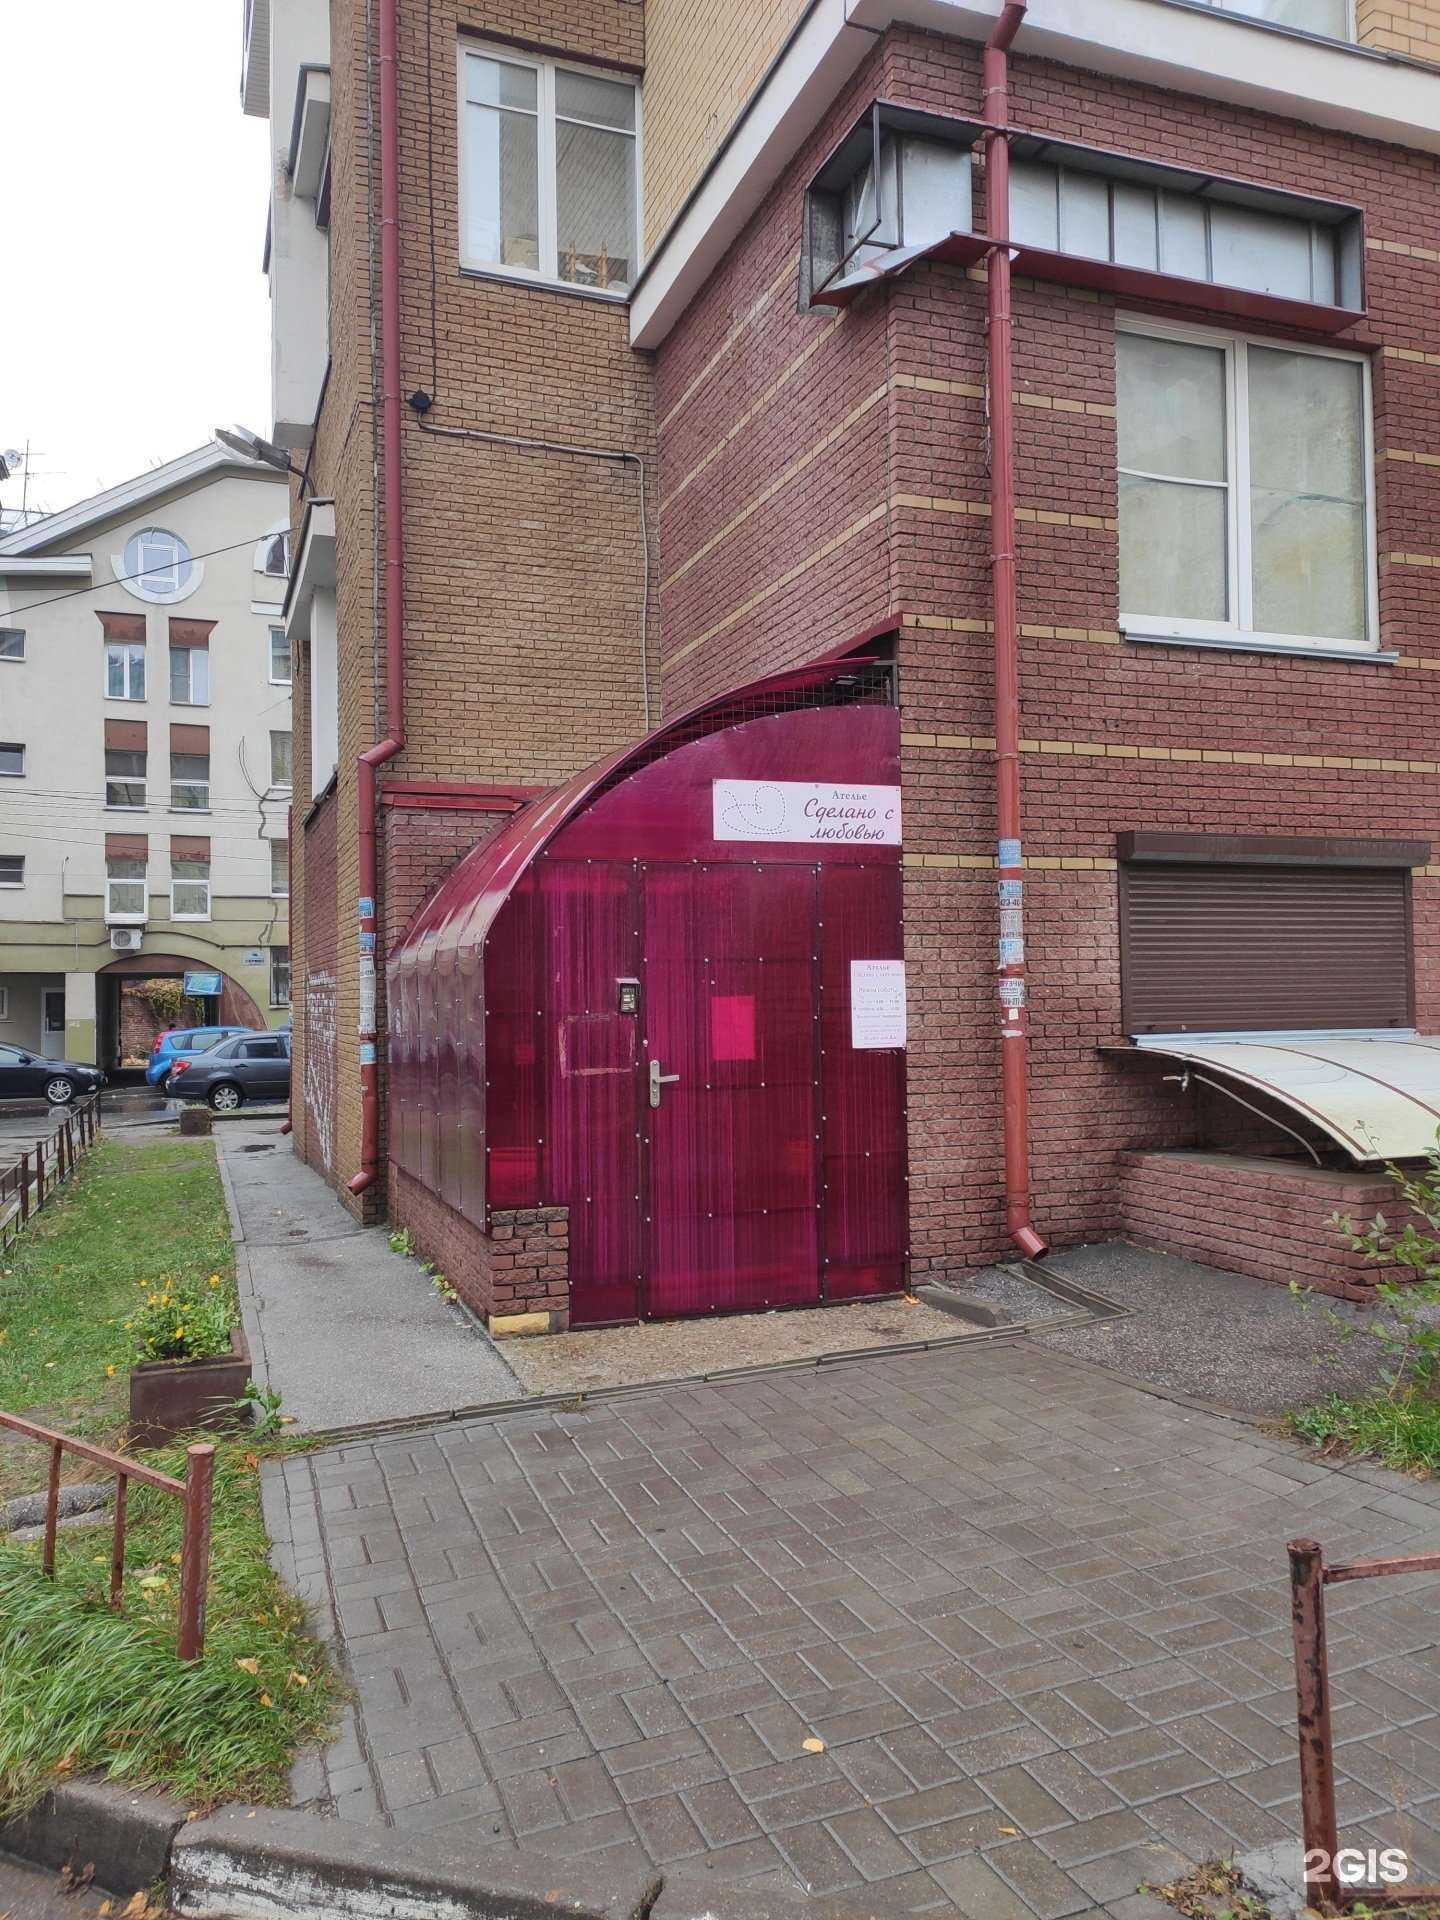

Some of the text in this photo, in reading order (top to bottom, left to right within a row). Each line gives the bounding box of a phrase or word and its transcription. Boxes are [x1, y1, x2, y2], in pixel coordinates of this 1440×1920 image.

[832, 790, 867, 800] Ателье
[804, 798, 895, 823] Сделано с
[810, 823, 885, 840] любовью
